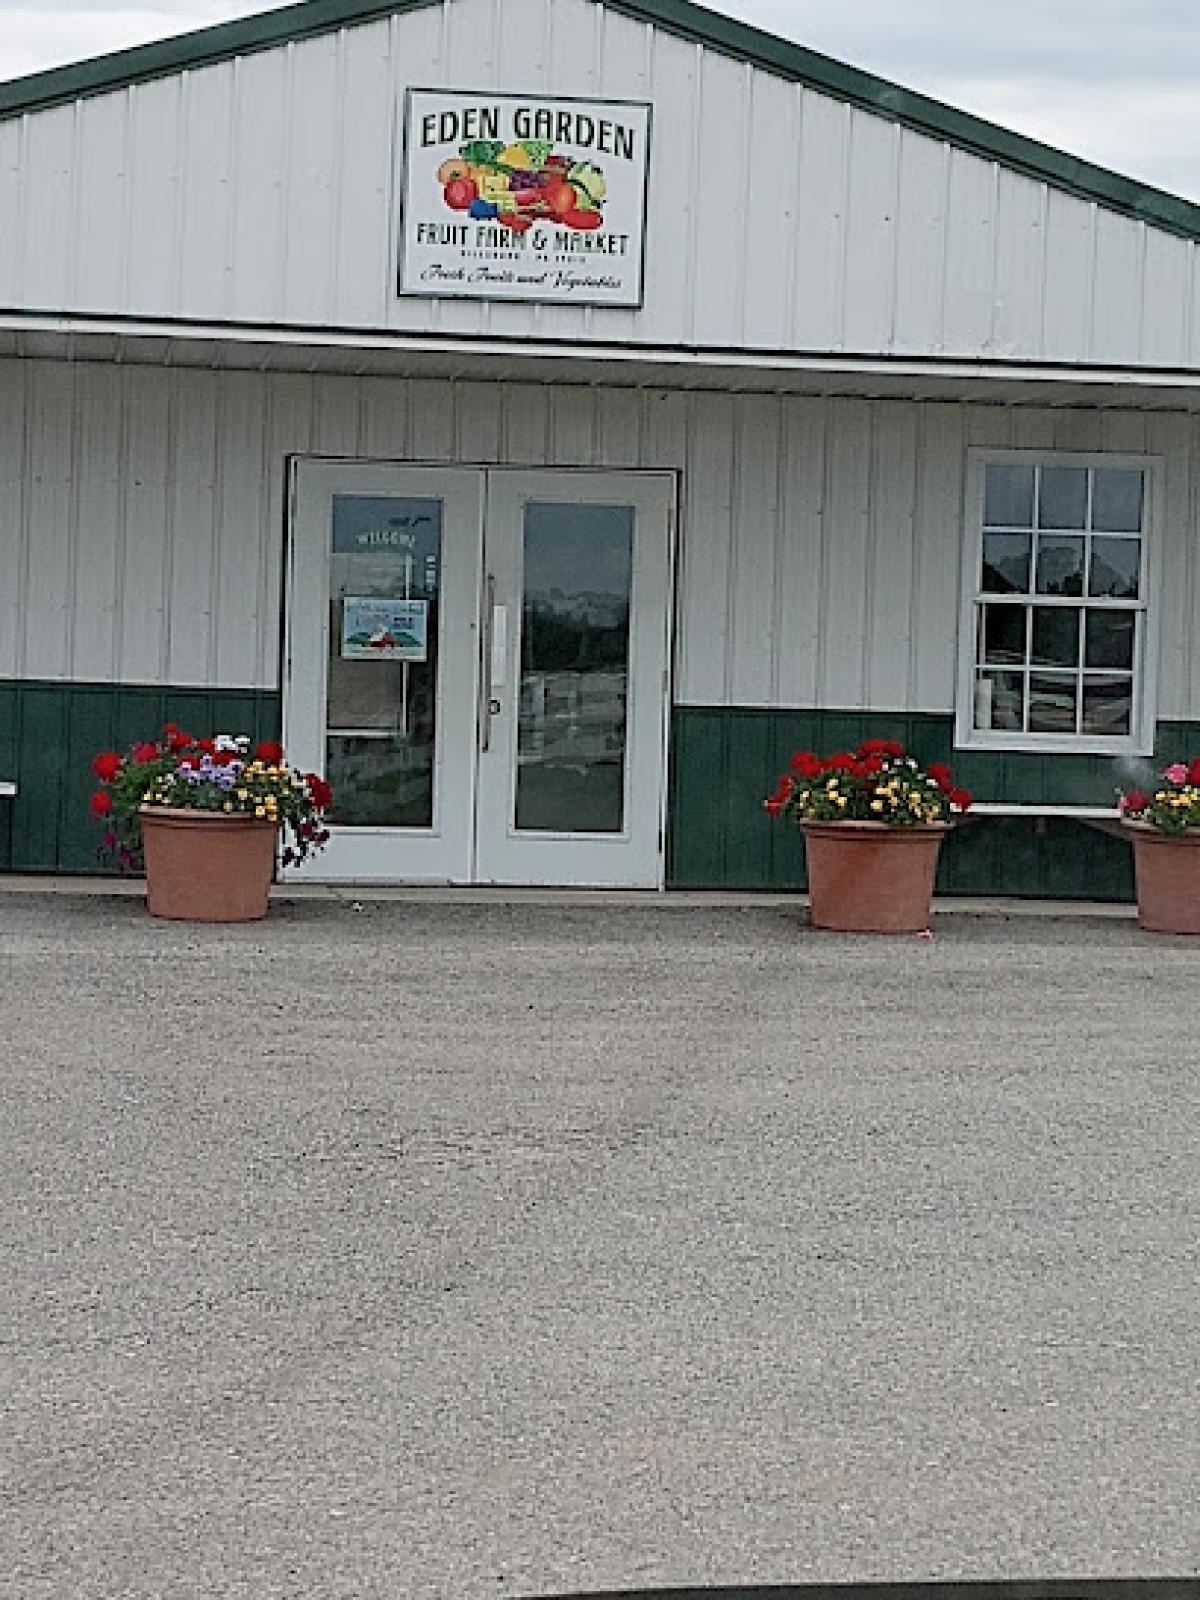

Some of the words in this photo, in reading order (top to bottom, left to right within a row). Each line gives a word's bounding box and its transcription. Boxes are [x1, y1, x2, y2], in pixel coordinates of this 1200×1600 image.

[421, 107, 500, 147] EDEN
[513, 107, 634, 161] GARDEN
[417, 223, 469, 246] FRUIT
[476, 226, 527, 251] FARM
[532, 229, 548, 251] &
[552, 231, 630, 257] MARKET
